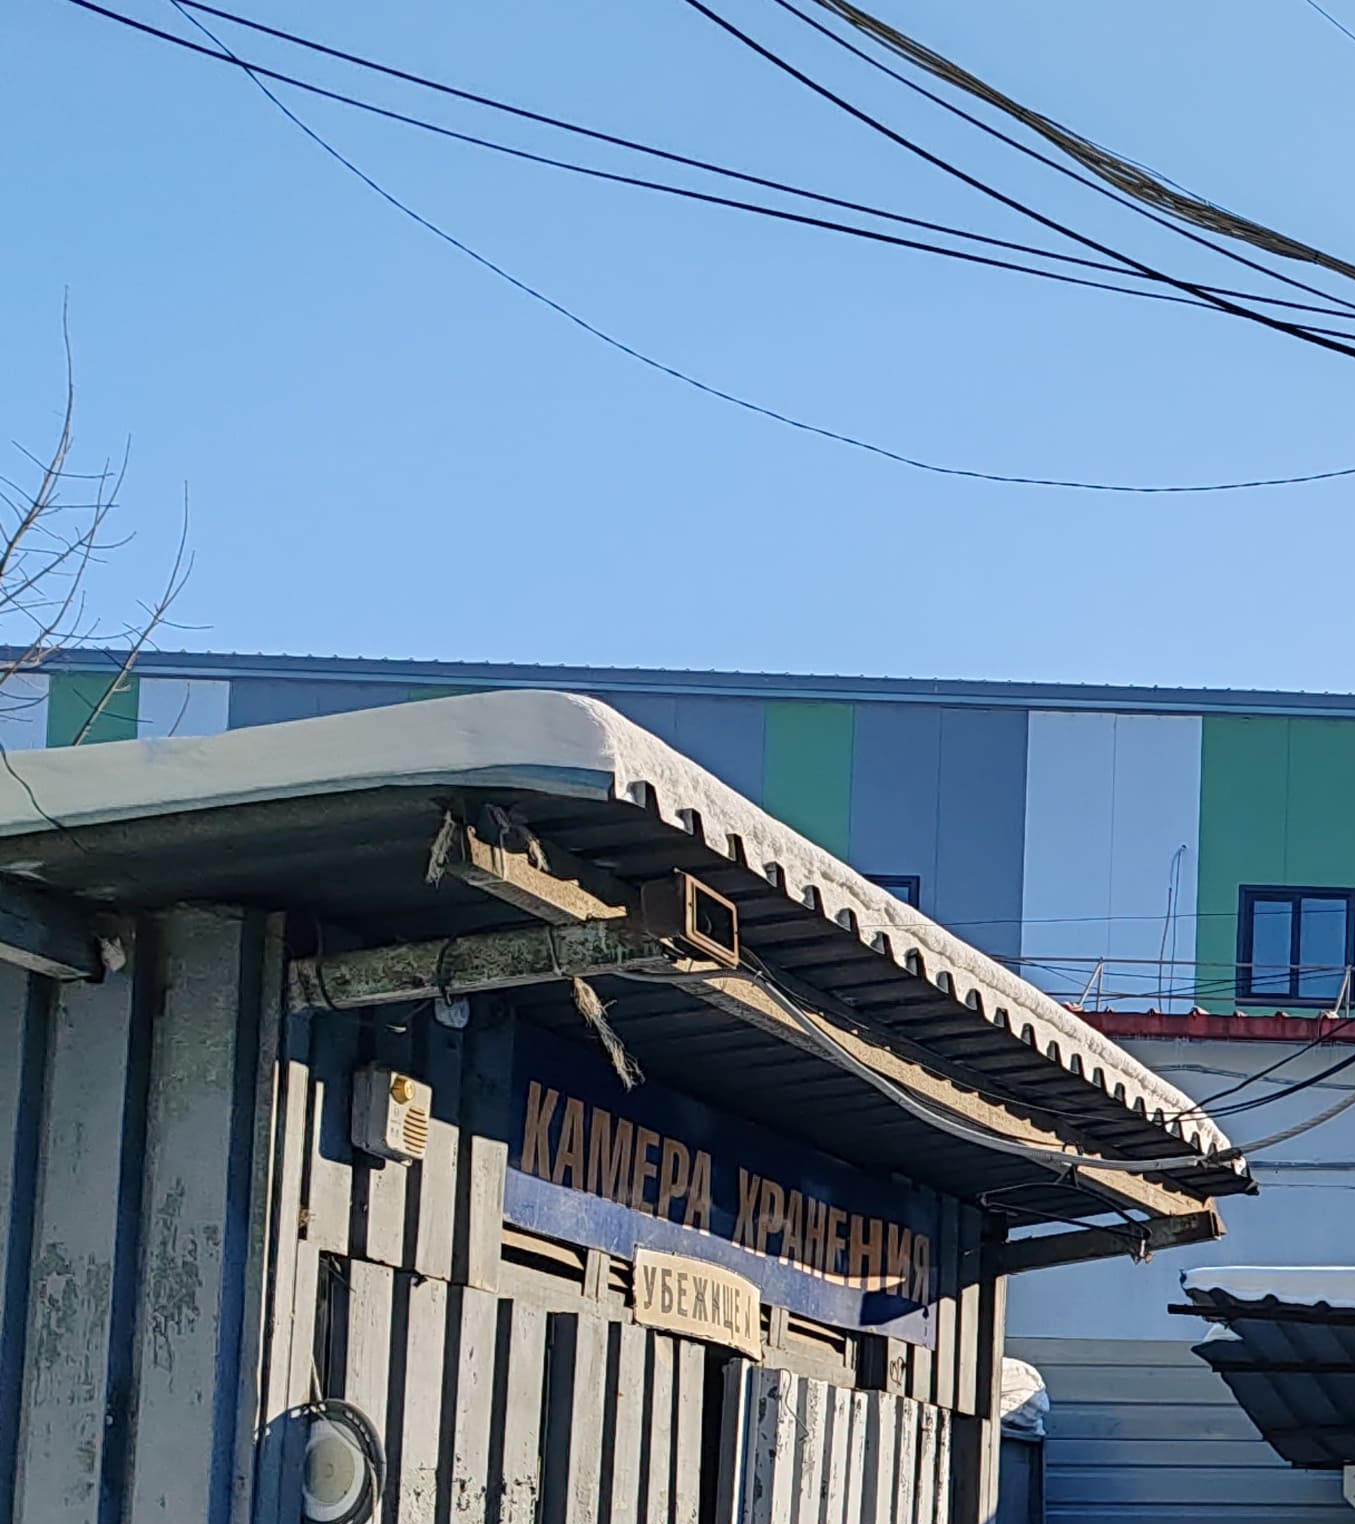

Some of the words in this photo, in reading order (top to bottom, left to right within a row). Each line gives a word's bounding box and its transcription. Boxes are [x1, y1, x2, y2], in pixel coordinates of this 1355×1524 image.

[520, 1080, 712, 1237] КАМЕРА
[731, 1166, 930, 1306] ХРАНЕНИЯ
[642, 1264, 741, 1340] УБЕЖИЩЕ
